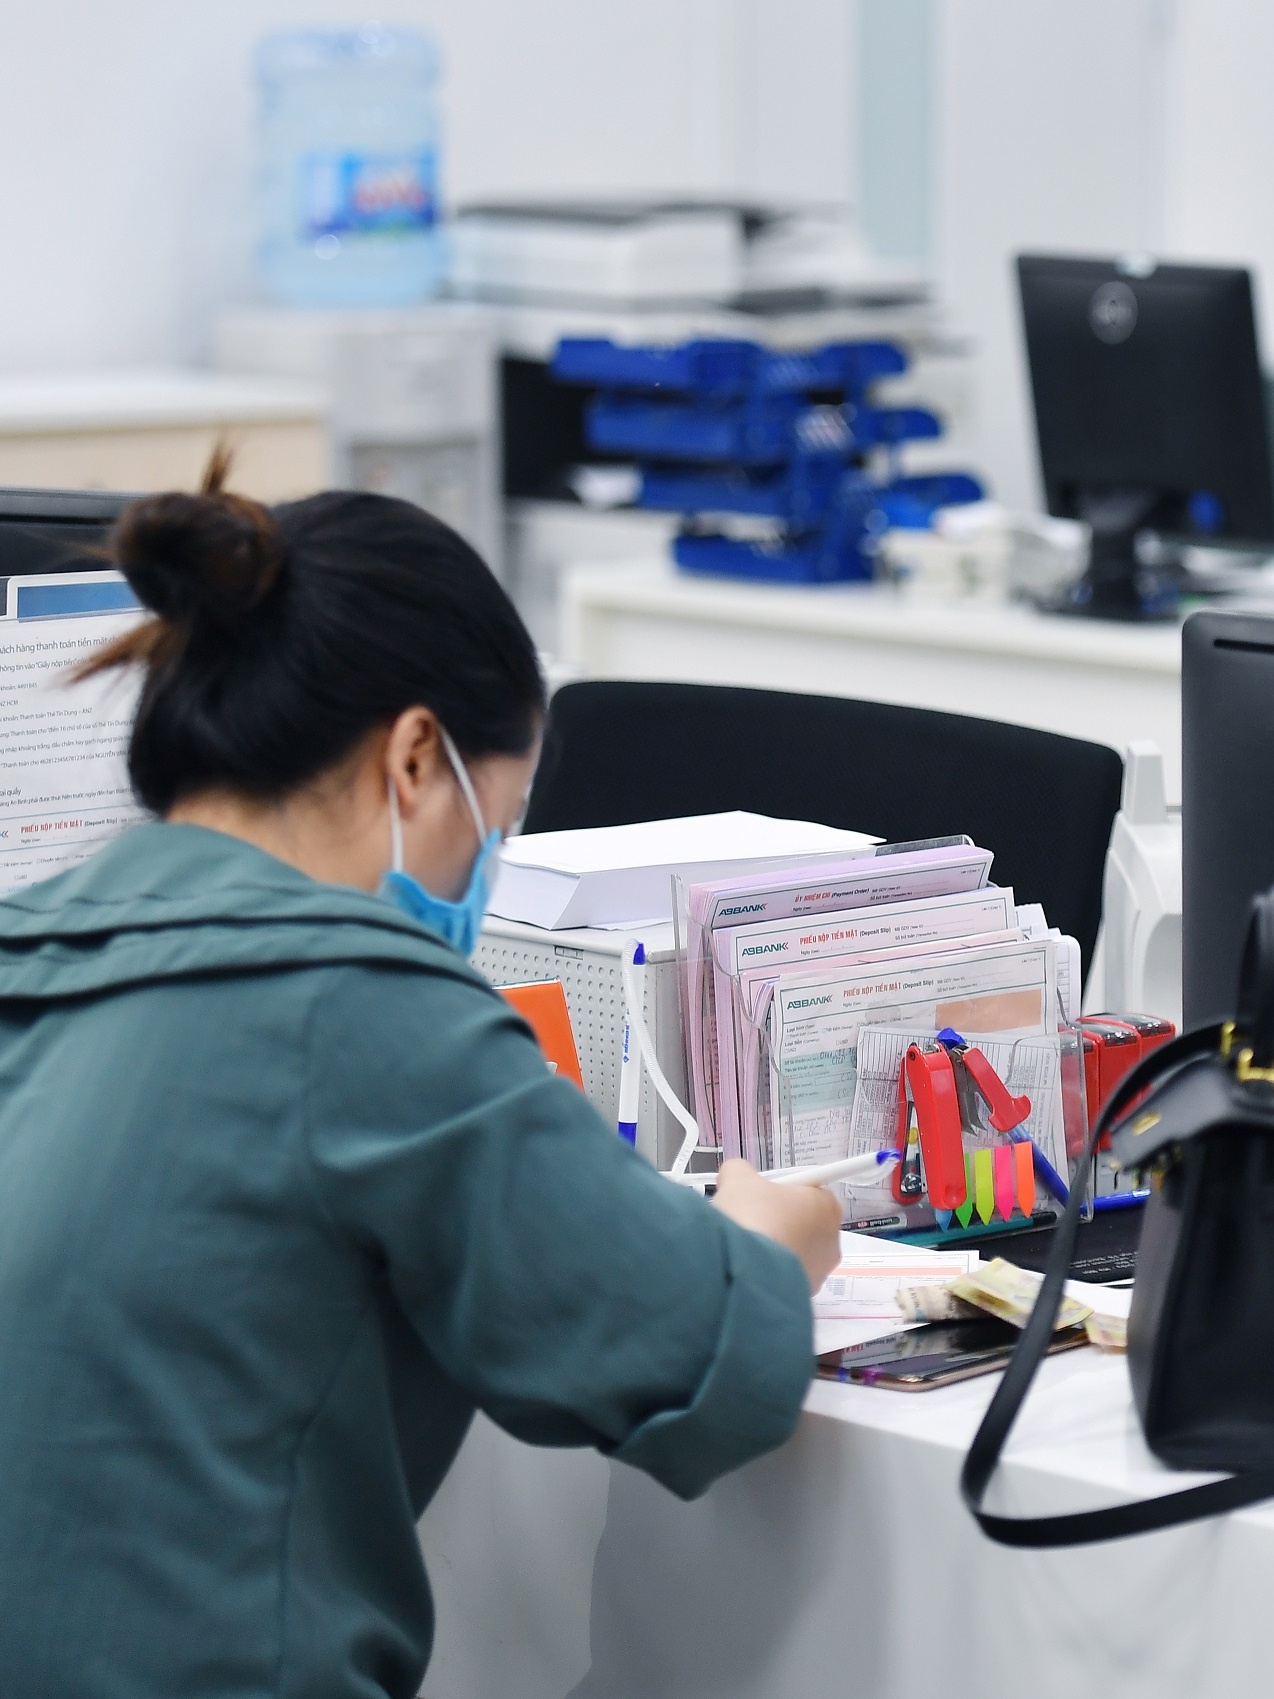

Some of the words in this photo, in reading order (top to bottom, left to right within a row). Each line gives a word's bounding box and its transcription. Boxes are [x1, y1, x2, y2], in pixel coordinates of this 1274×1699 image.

[16, 644, 35, 654] hàng
[36, 641, 58, 651] thanh
[59, 640, 76, 649] toán
[831, 890, 854, 899] (Payment
[854, 887, 870, 895] Order)
[718, 903, 764, 917] ABBANK
[800, 934, 817, 945] PHIẾU
[817, 932, 830, 943] NỘP
[859, 927, 880, 938] (Deposit
[880, 926, 892, 935] Slip)
[741, 942, 786, 957] ABBANK
[843, 985, 861, 998] PHIẾU
[861, 984, 874, 996] NỘP
[902, 981, 922, 990] (Deposit
[922, 979, 934, 987] Slip)
[786, 995, 830, 1010] ABBANK
